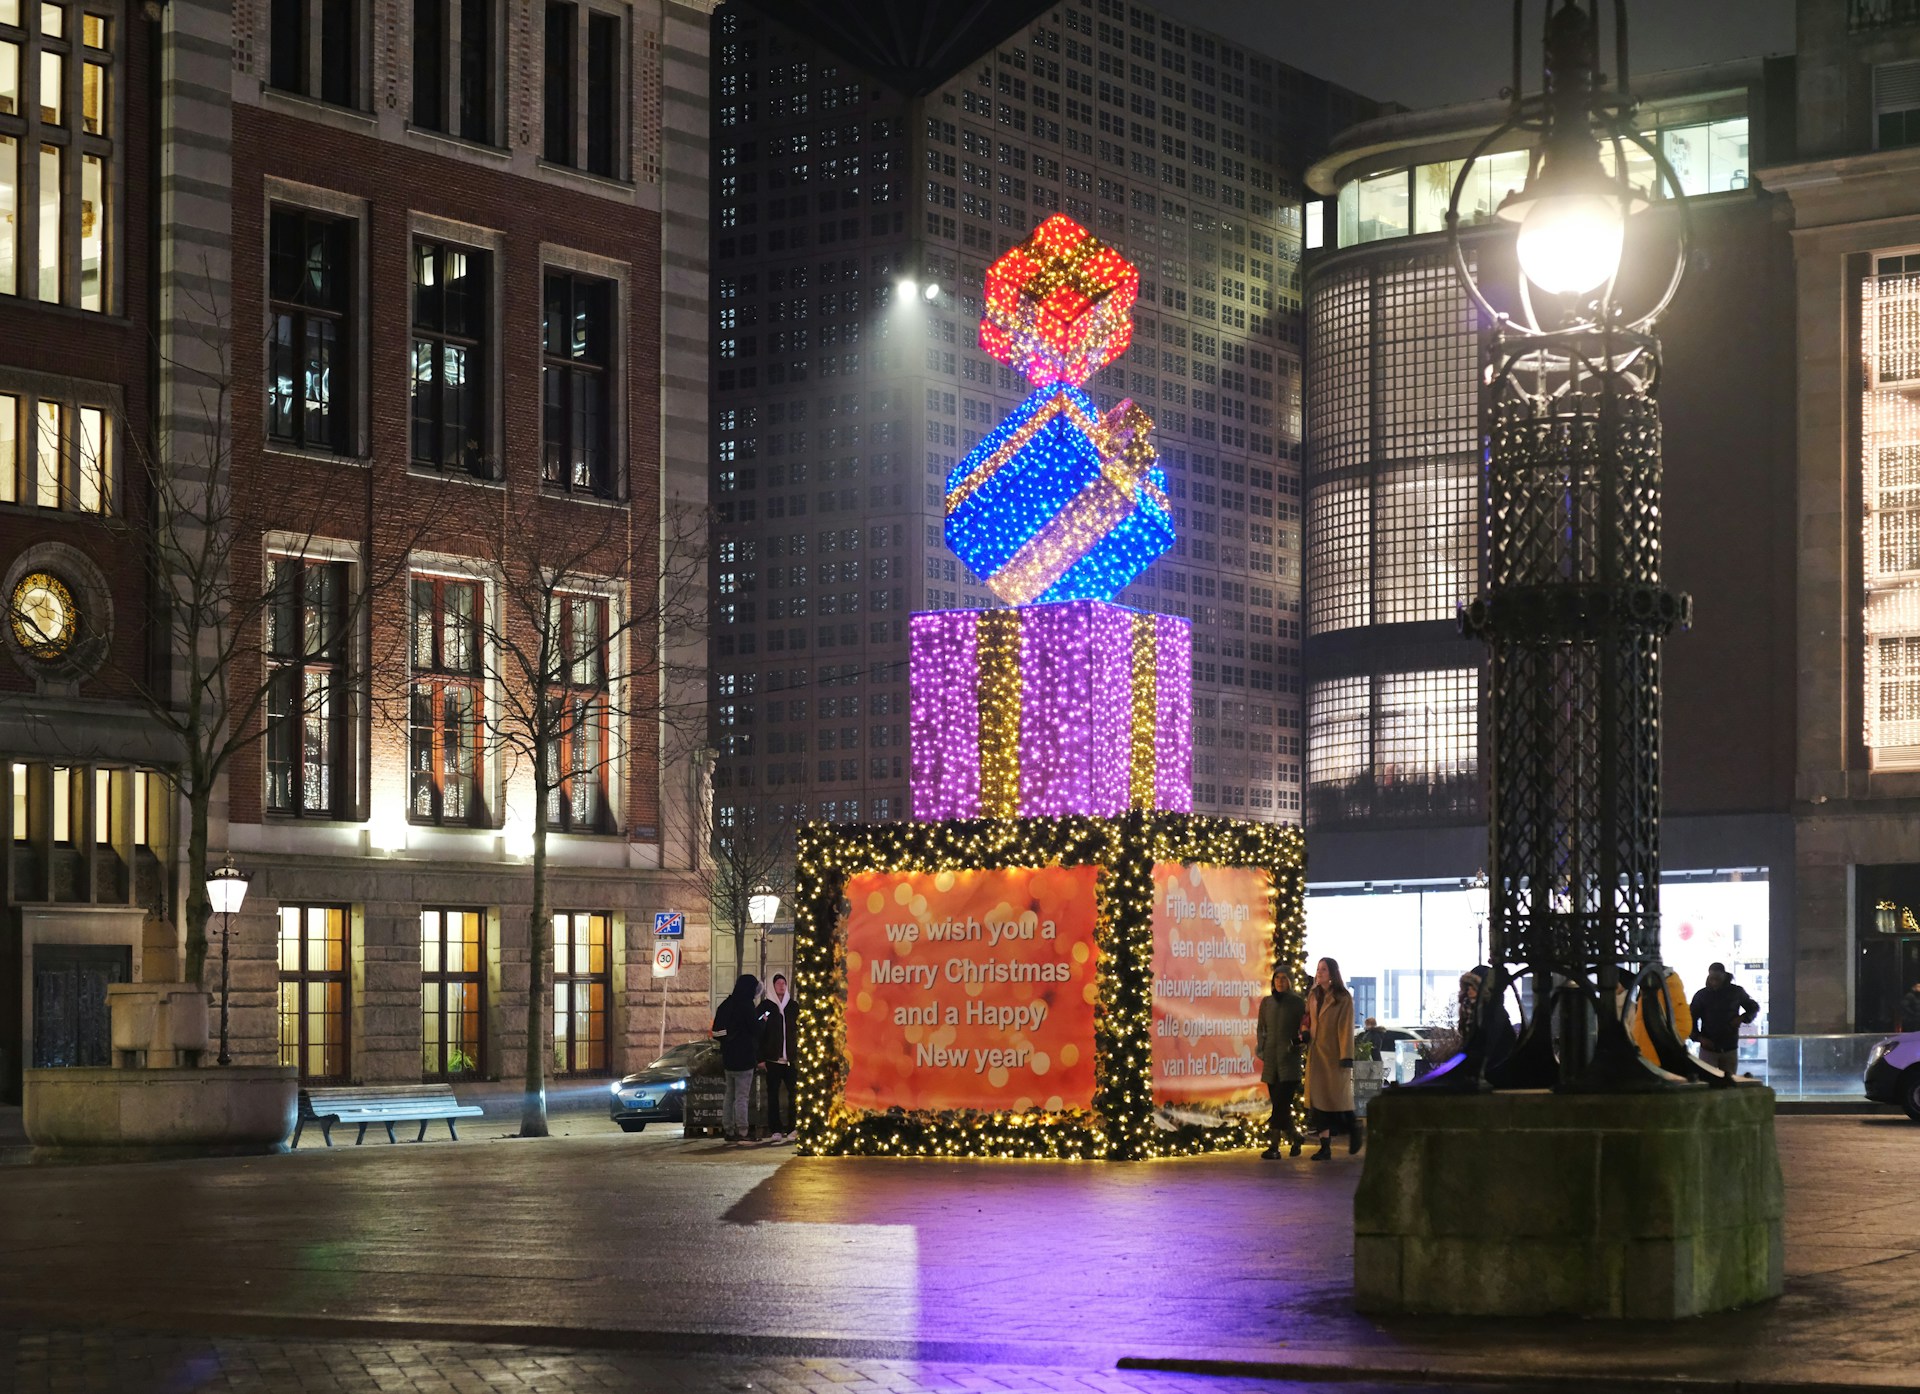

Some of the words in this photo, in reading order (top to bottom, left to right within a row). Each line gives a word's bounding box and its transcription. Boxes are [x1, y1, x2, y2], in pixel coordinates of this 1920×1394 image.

[1166, 895, 1196, 924] Fijne
[1200, 897, 1232, 926] dagen
[1234, 903, 1250, 920] en
[885, 922, 919, 942] we
[926, 916, 981, 941] wish
[988, 920, 1036, 946] you
[1041, 920, 1056, 939] a
[660, 954, 672, 963] 30
[1172, 939, 1194, 957] een
[1198, 936, 1247, 965] gelukkig
[871, 959, 939, 990] Merry
[944, 958, 1071, 983] Christmas
[1155, 974, 1214, 1004] nieuwjaar
[1217, 979, 1262, 997] namens
[893, 1001, 939, 1026] and
[945, 1006, 959, 1025] a
[966, 1000, 1045, 1032] Happy
[1157, 1014, 1180, 1037] alle
[1183, 1014, 1258, 1037] ondernemers
[916, 1042, 969, 1068] New
[974, 1047, 1030, 1074] year
[1162, 1058, 1185, 1077] van
[1188, 1054, 1208, 1076] het
[1210, 1053, 1255, 1075] Damrak
